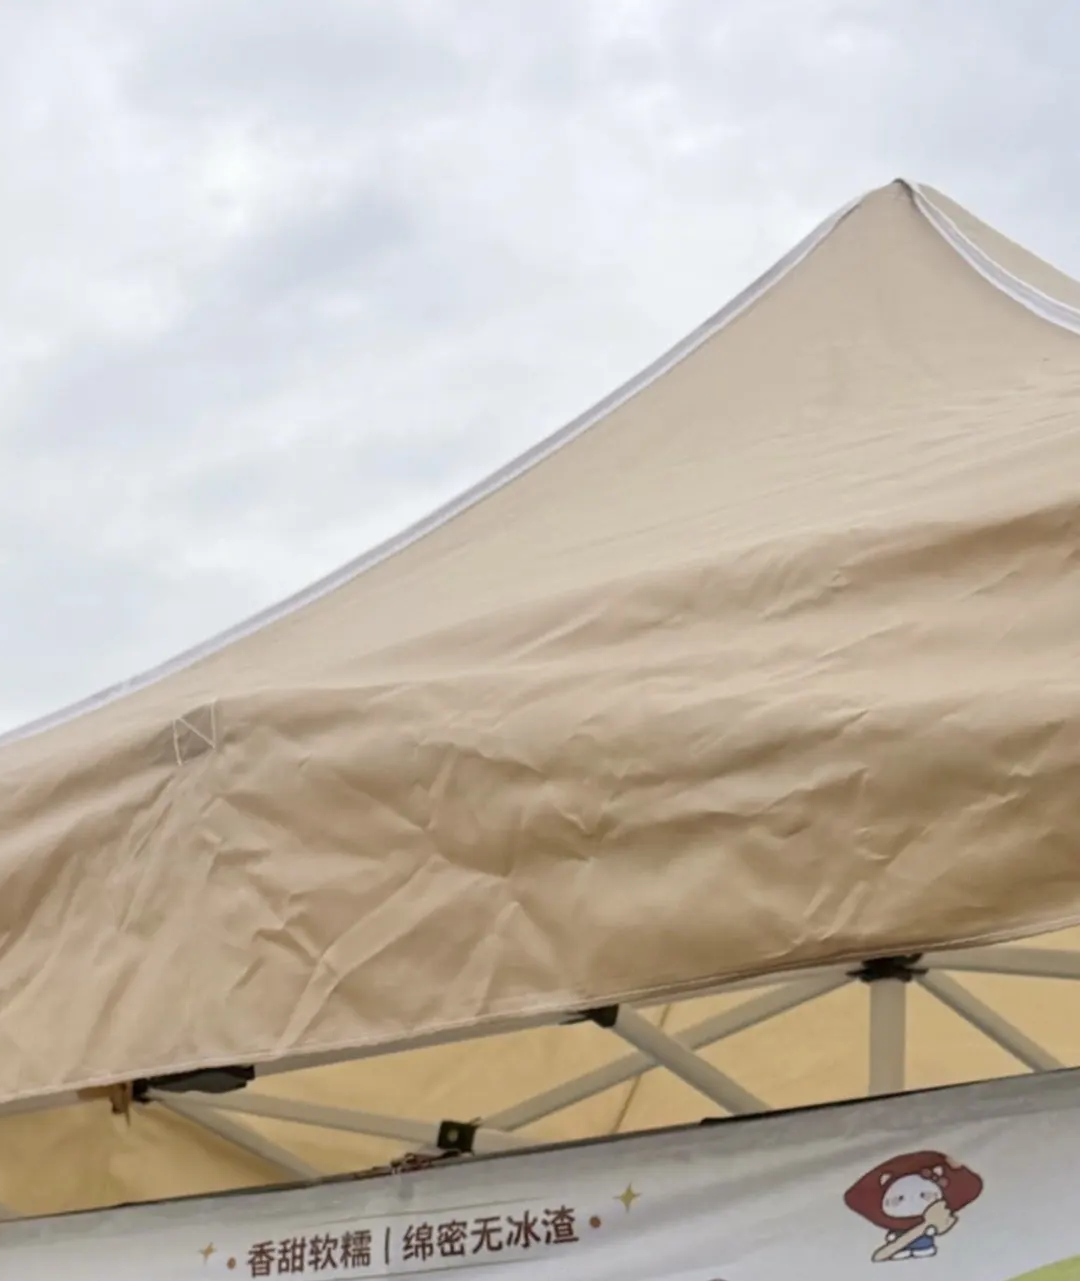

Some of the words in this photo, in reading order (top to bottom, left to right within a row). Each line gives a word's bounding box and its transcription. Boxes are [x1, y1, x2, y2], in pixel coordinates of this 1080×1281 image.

[247, 1229, 372, 1278] 香甜软糯
[402, 1205, 580, 1262] 绵密无冰渣
